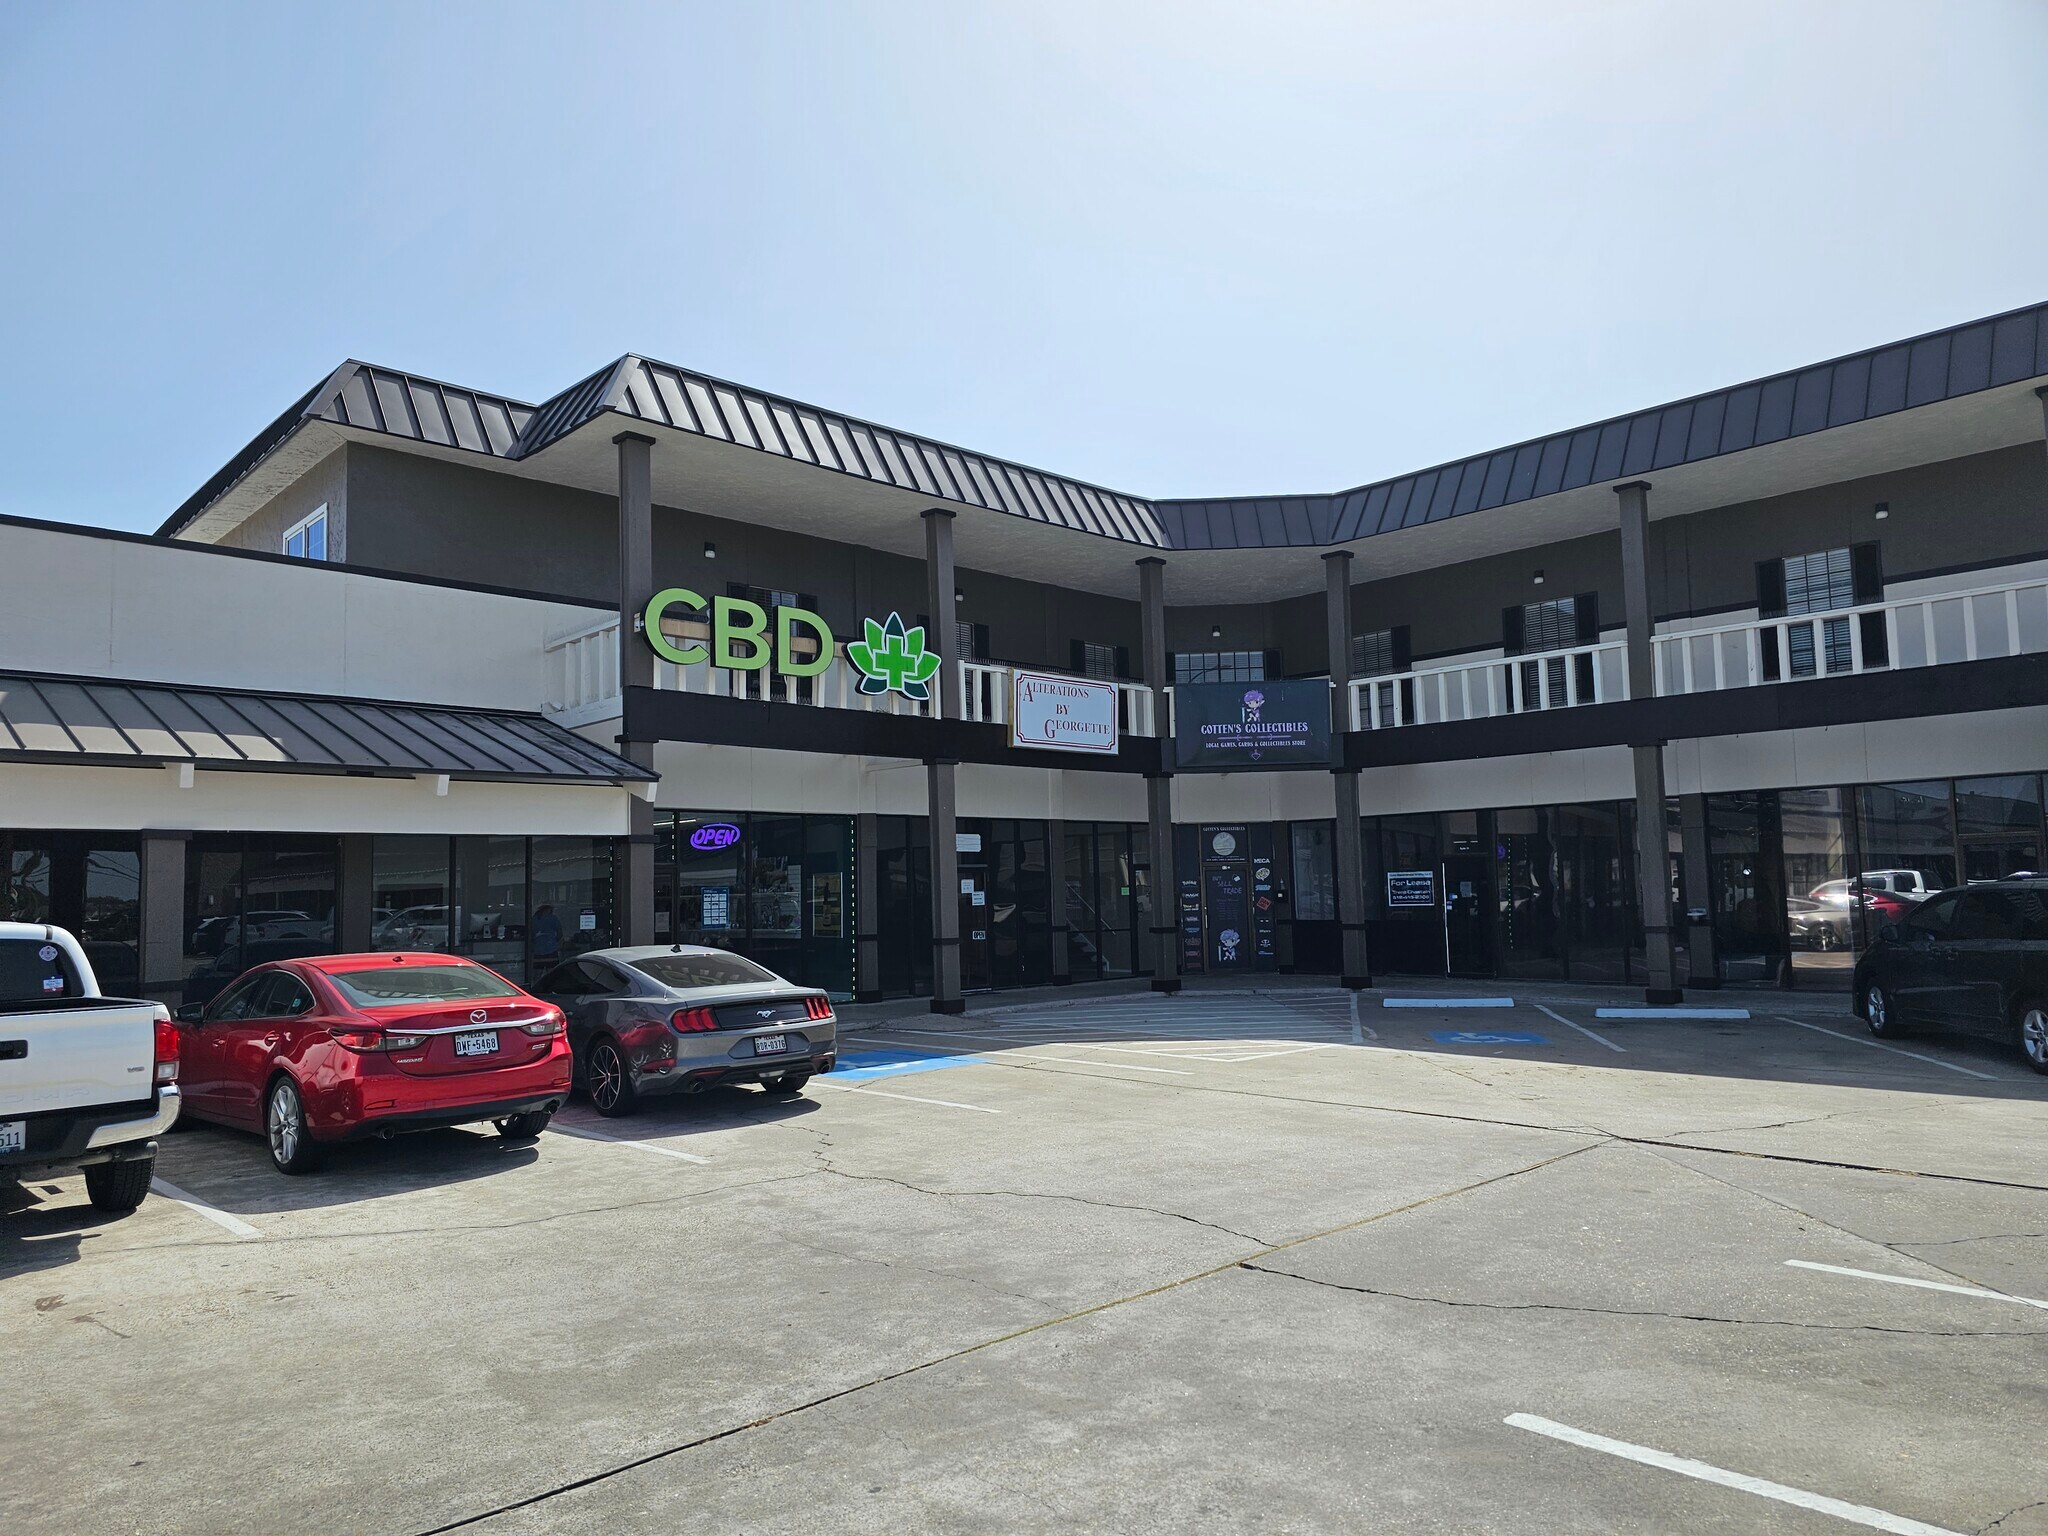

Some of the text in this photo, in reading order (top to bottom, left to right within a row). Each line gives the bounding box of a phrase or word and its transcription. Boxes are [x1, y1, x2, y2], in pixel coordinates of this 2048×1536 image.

[643, 587, 835, 678] CBD
[1022, 681, 1090, 703] ALTERATIONS
[1056, 703, 1070, 715] BY
[1044, 718, 1110, 739] GEORGETTE
[1201, 721, 1308, 735] COTTEN'S COLLECTIBLES
[693, 827, 736, 847] OPEN
